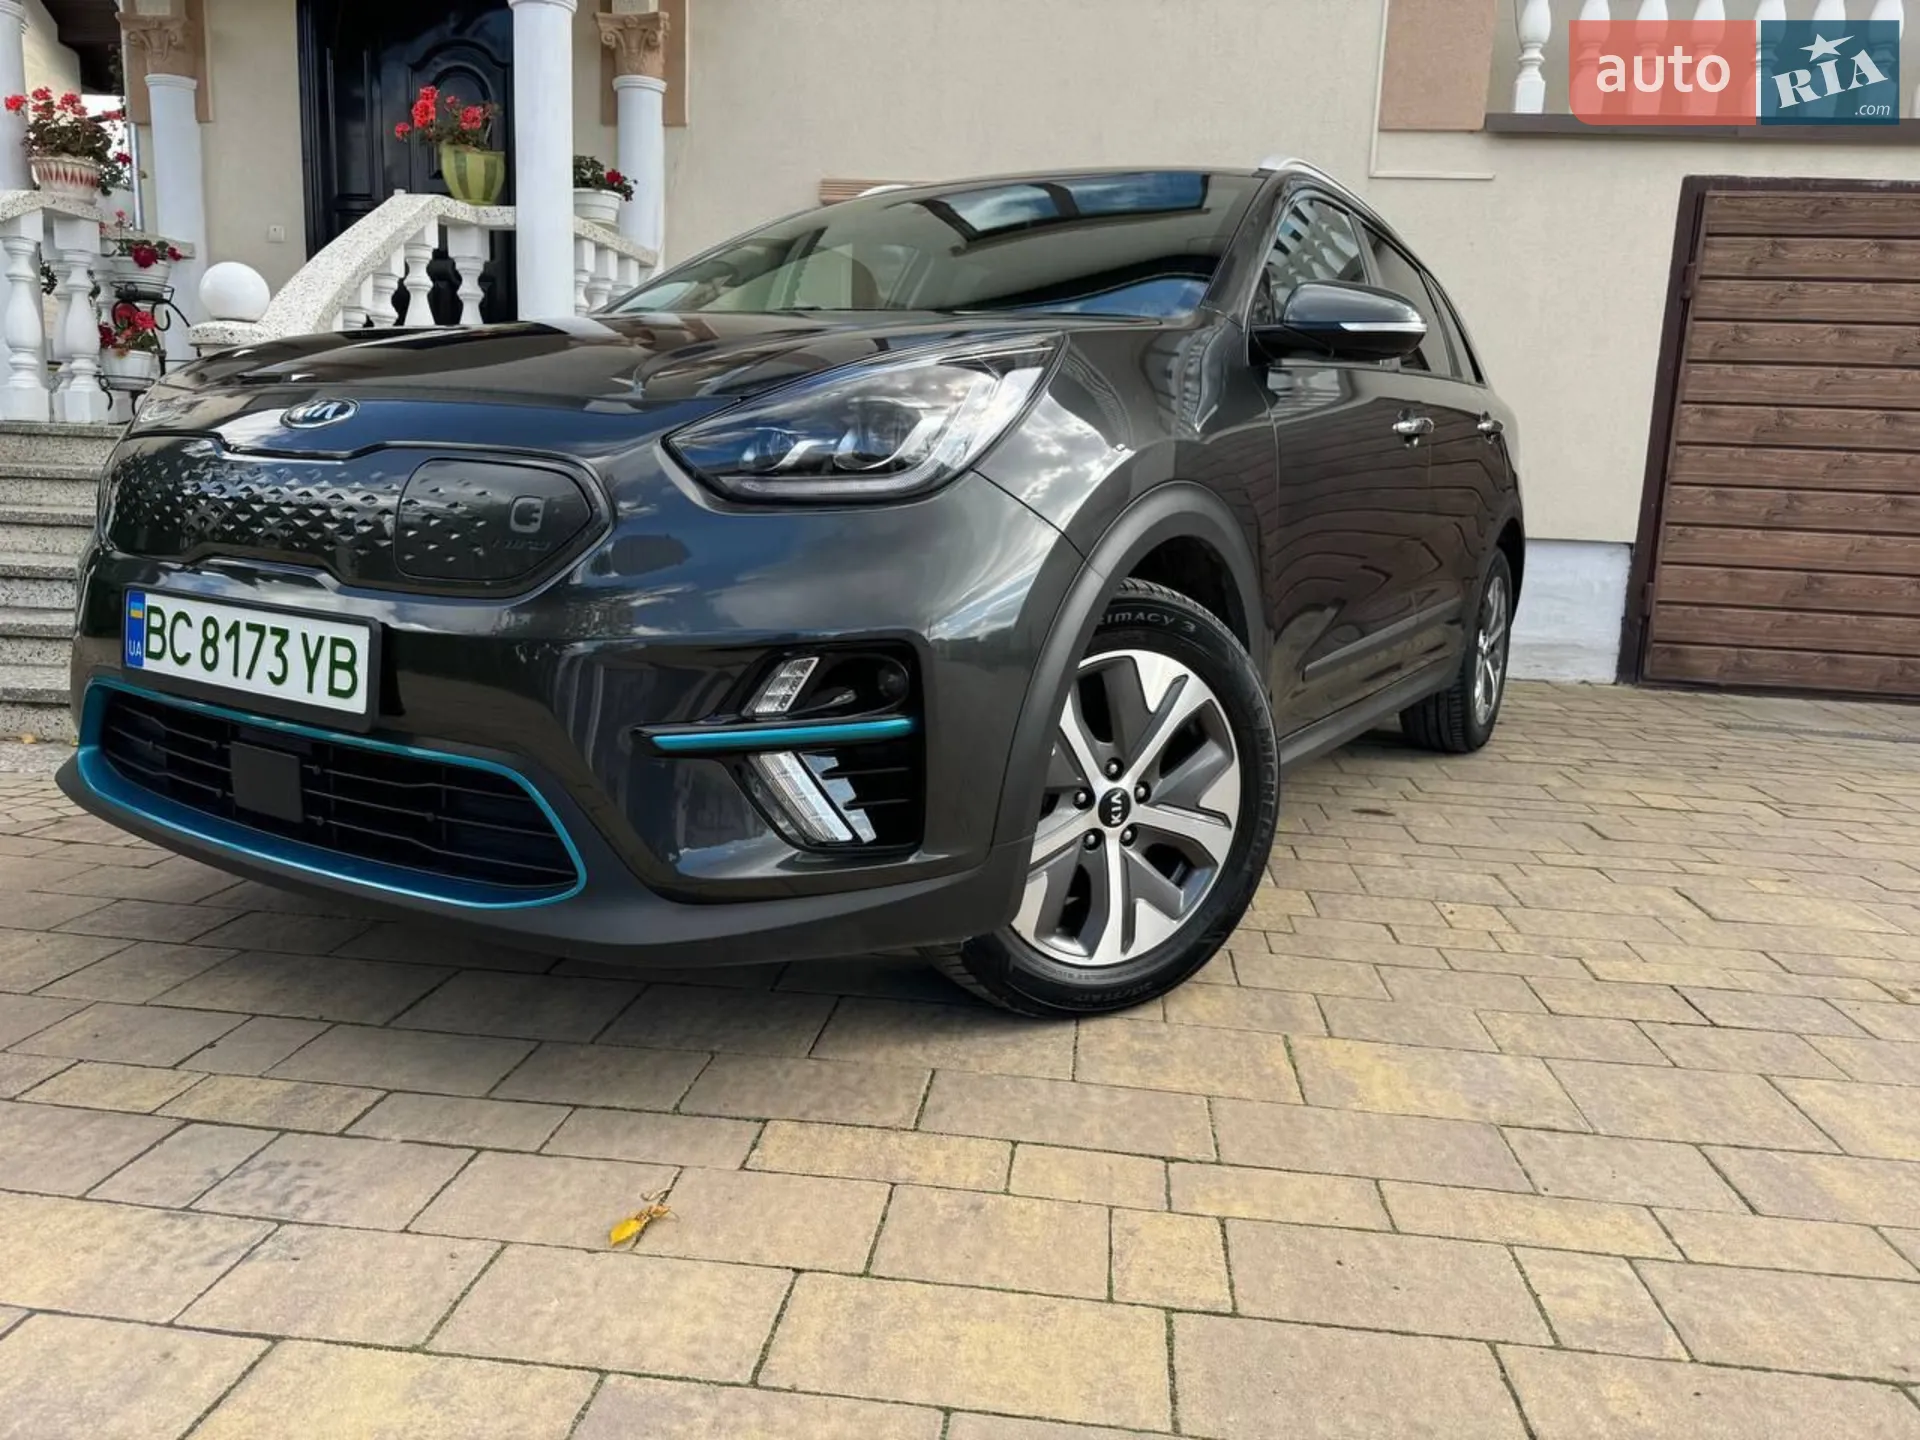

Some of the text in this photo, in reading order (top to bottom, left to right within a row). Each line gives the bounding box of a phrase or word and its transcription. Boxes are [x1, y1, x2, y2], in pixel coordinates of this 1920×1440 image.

[1181, 620, 1197, 633] 3
[128, 639, 142, 657] UA
[145, 604, 358, 699] BC 8173 YB
[1110, 792, 1122, 825] KIA
